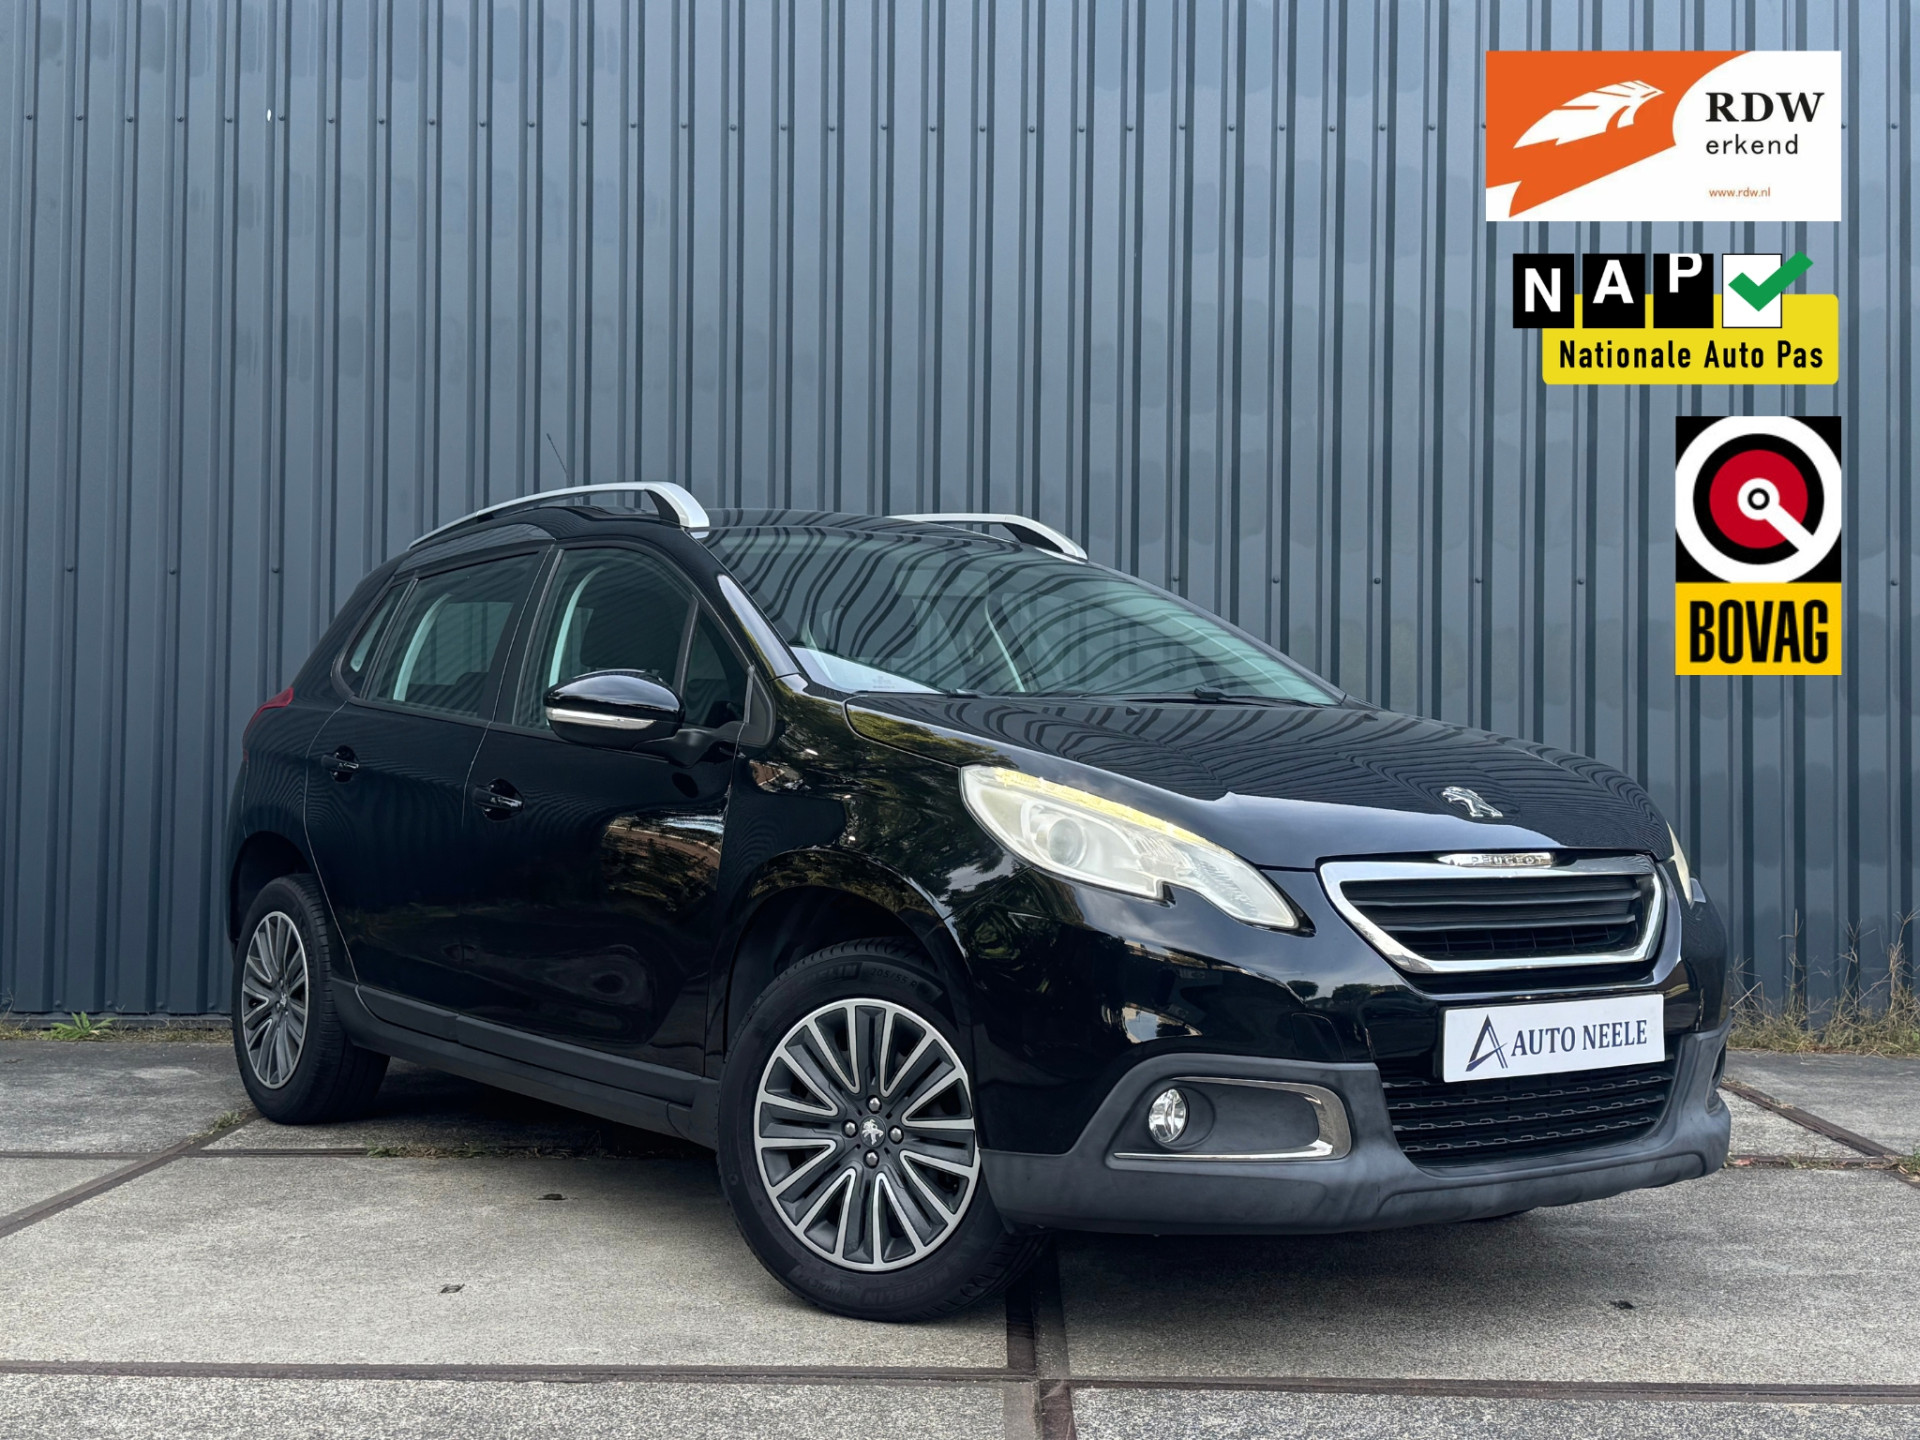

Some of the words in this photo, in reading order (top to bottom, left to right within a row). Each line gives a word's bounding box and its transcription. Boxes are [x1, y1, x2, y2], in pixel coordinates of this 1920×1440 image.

[1471, 854, 1545, 866] PEUGEOT
[1511, 1026, 1576, 1057] AUTO
[1582, 1019, 1647, 1050] NEELE
